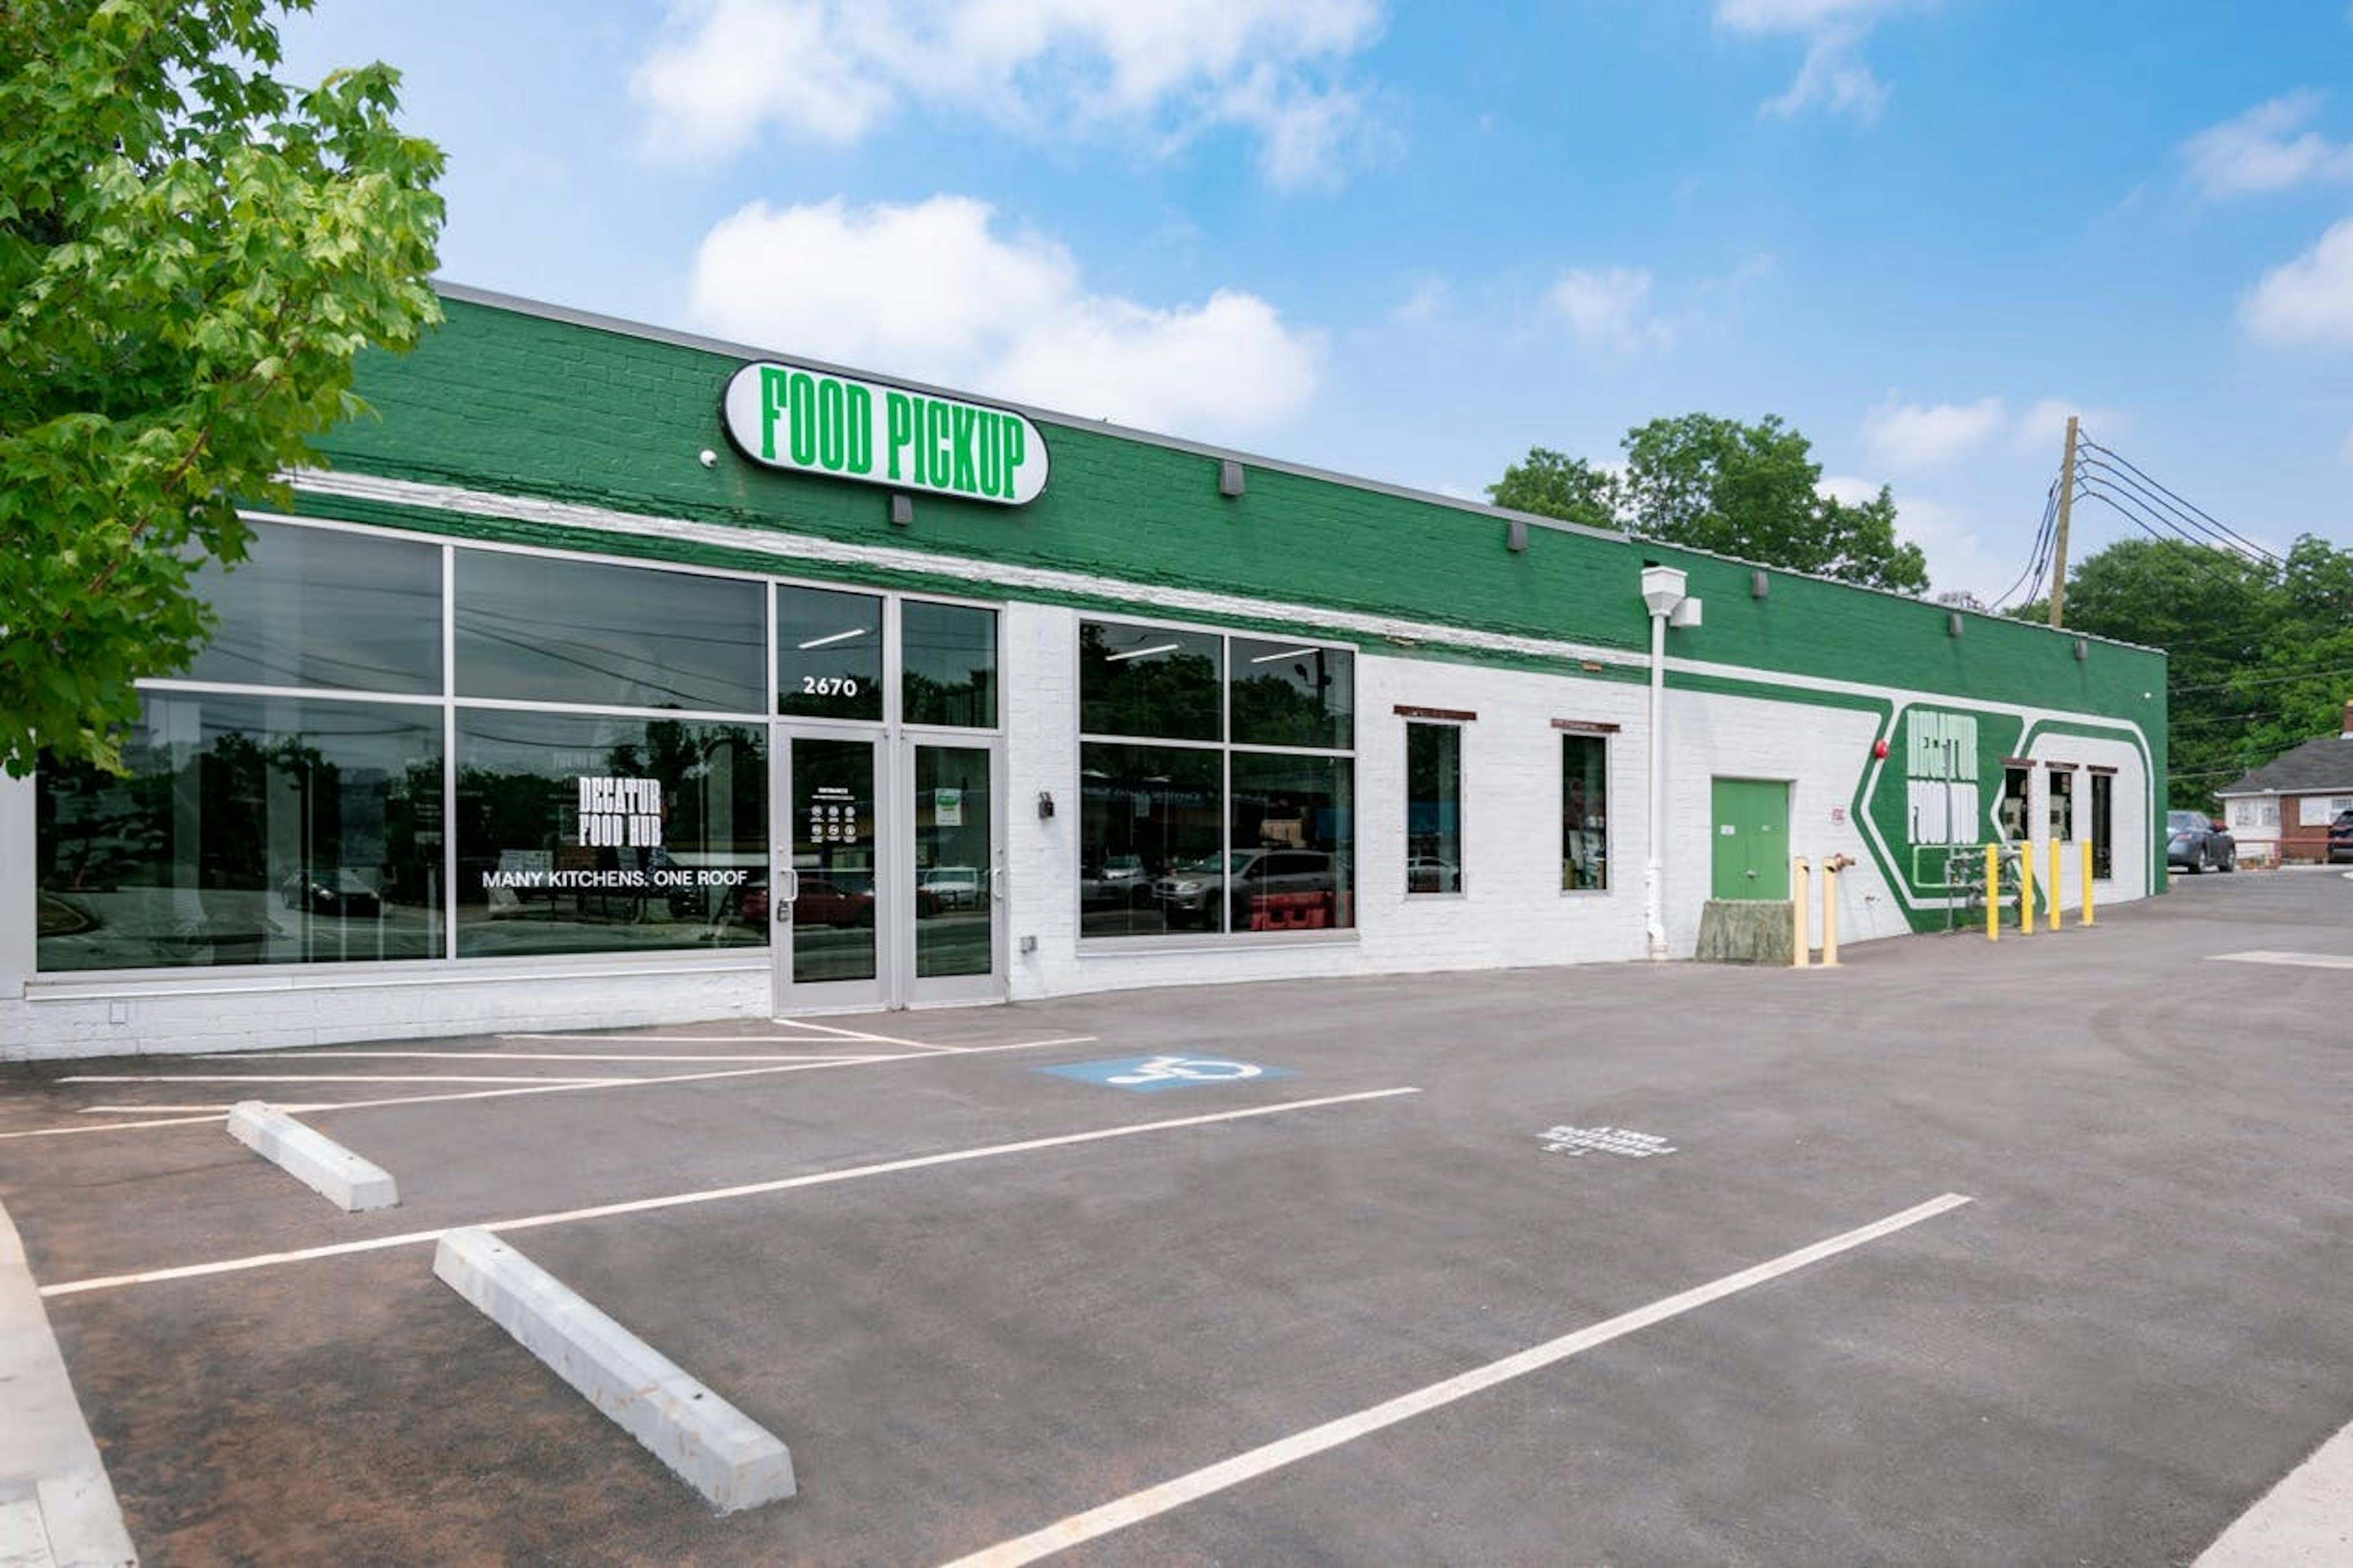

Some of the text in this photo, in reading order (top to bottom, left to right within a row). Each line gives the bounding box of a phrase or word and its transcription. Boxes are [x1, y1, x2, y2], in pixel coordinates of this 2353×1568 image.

[759, 366, 1025, 499] FOOD PICKUP
[803, 676, 858, 697] 2670
[578, 777, 661, 814] DECATUR
[578, 814, 662, 847] FOOD HUB
[482, 870, 544, 888] MANY
[654, 870, 693, 887] ONE
[697, 870, 748, 886] ROOF
